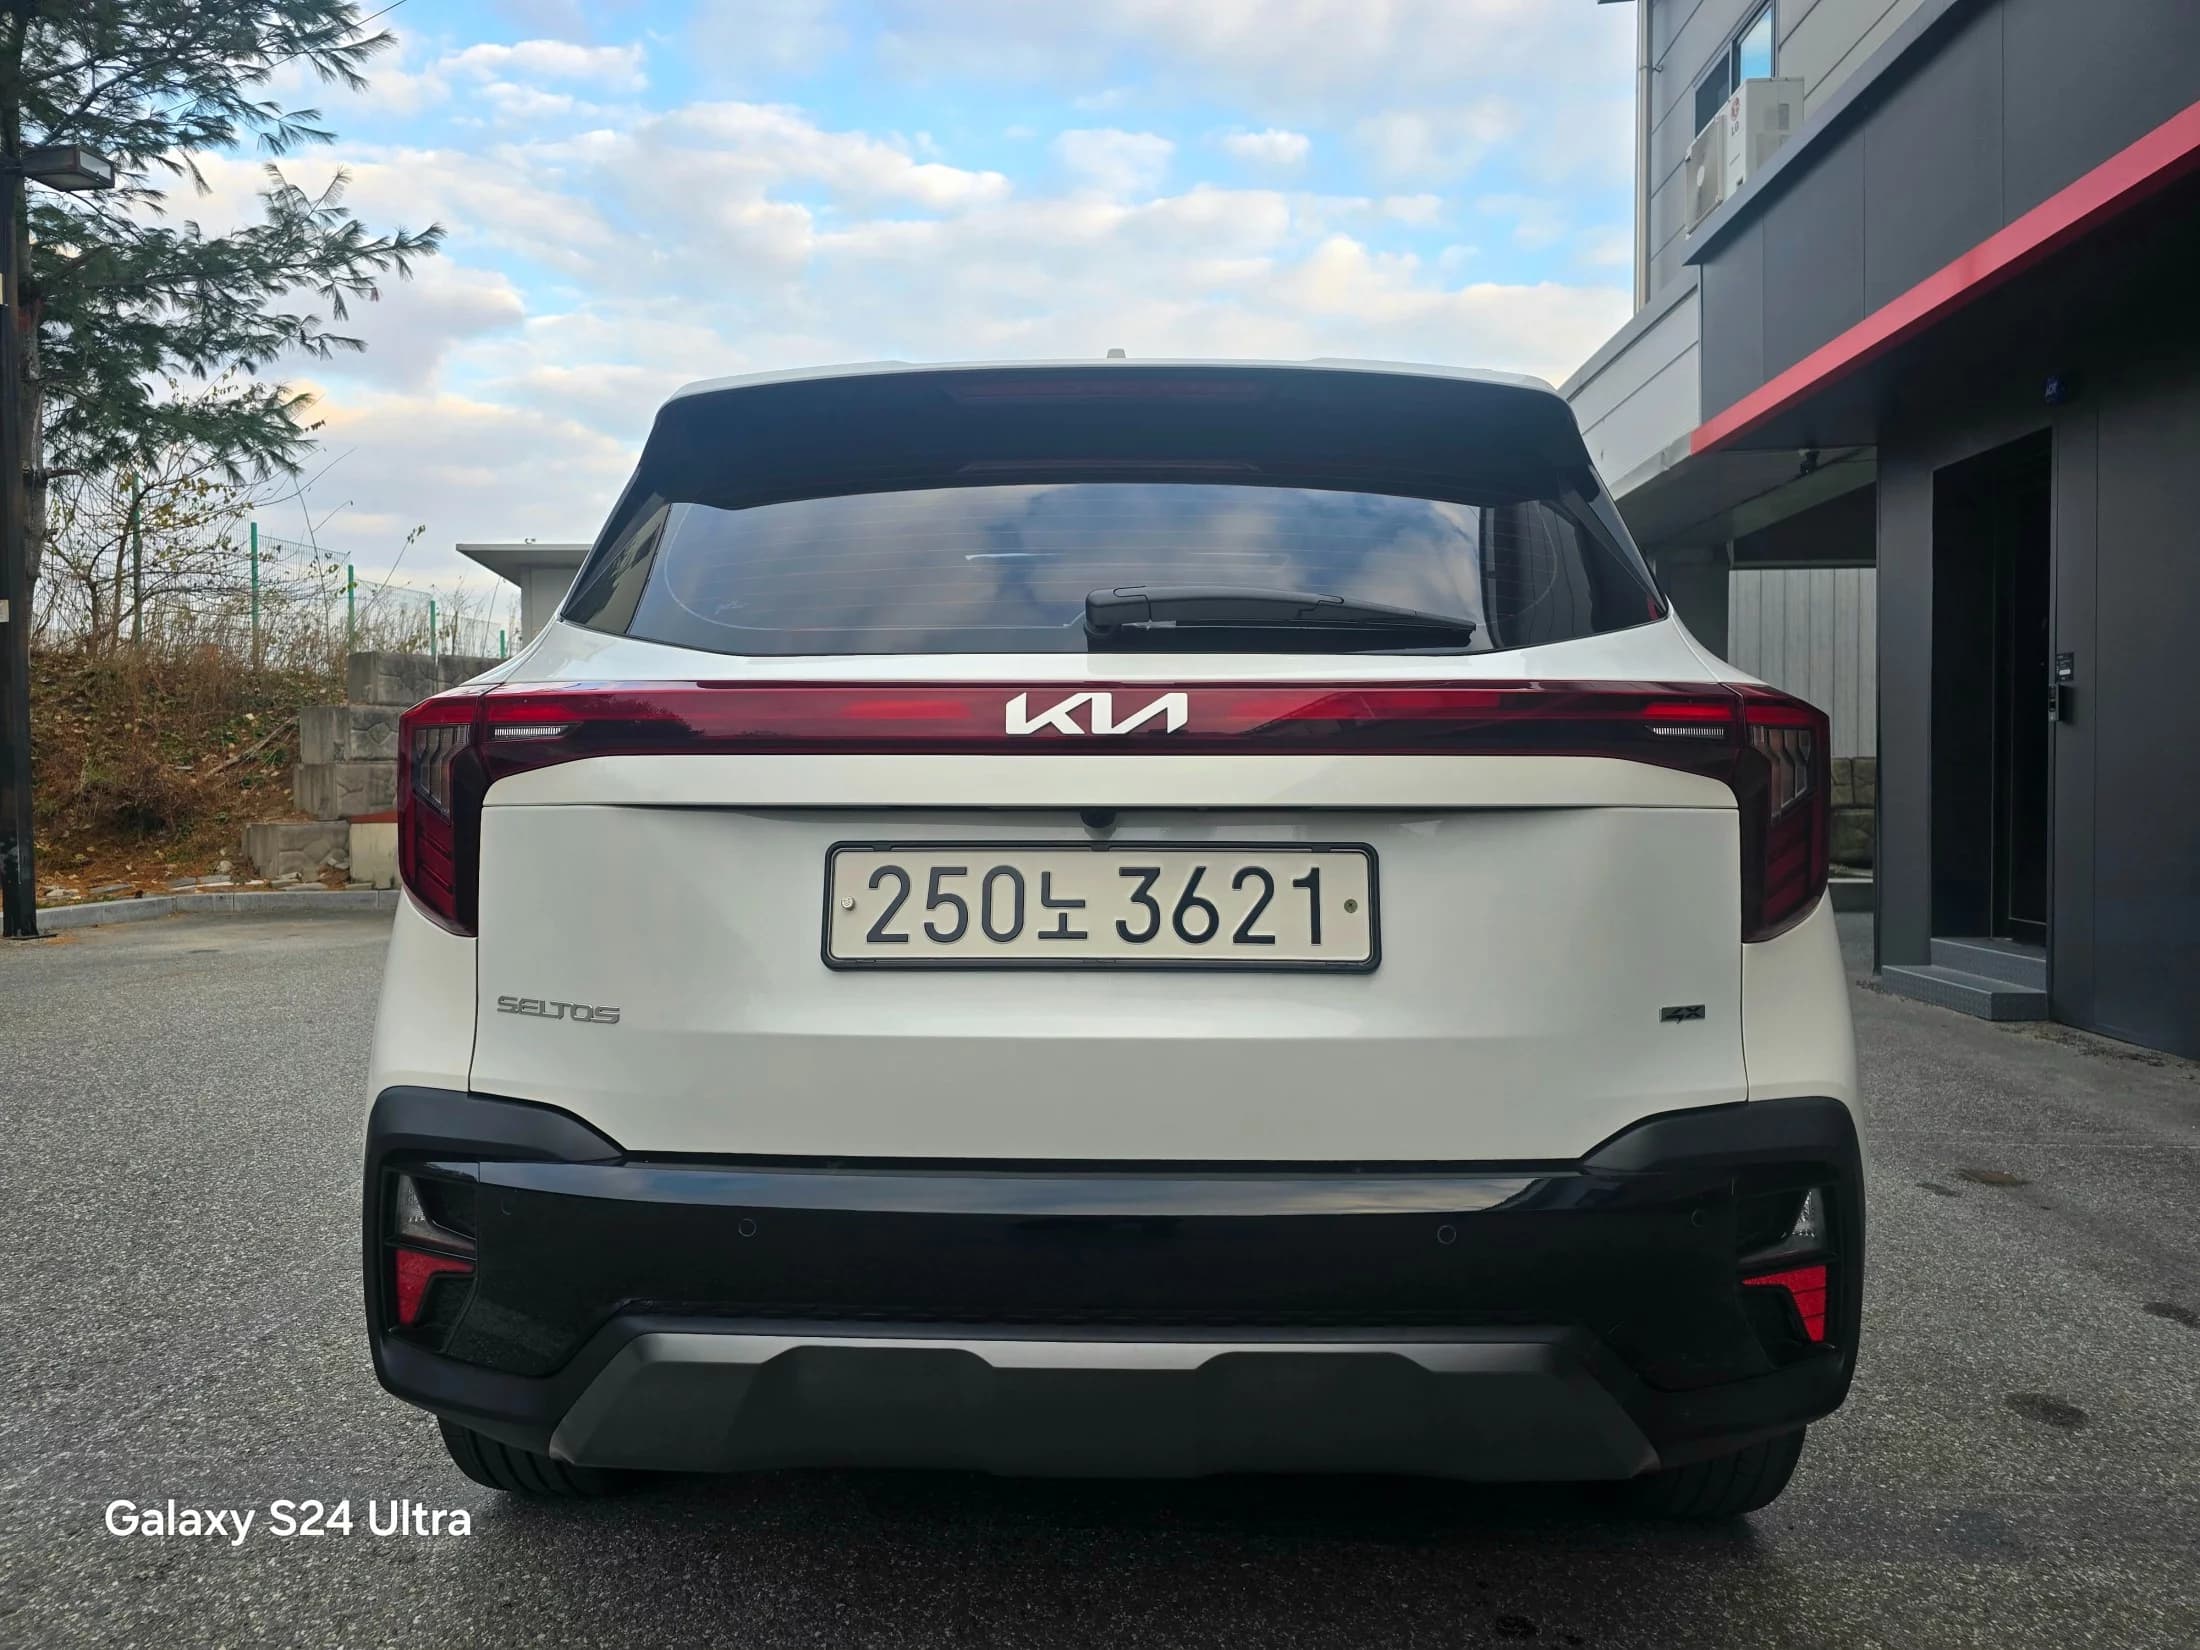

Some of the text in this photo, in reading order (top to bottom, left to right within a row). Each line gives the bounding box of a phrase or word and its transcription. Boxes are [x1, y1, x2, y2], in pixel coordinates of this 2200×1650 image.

[1006, 692, 1188, 734] KIA
[867, 865, 1322, 945] 250노 3621
[497, 995, 620, 1024] SELTOS
